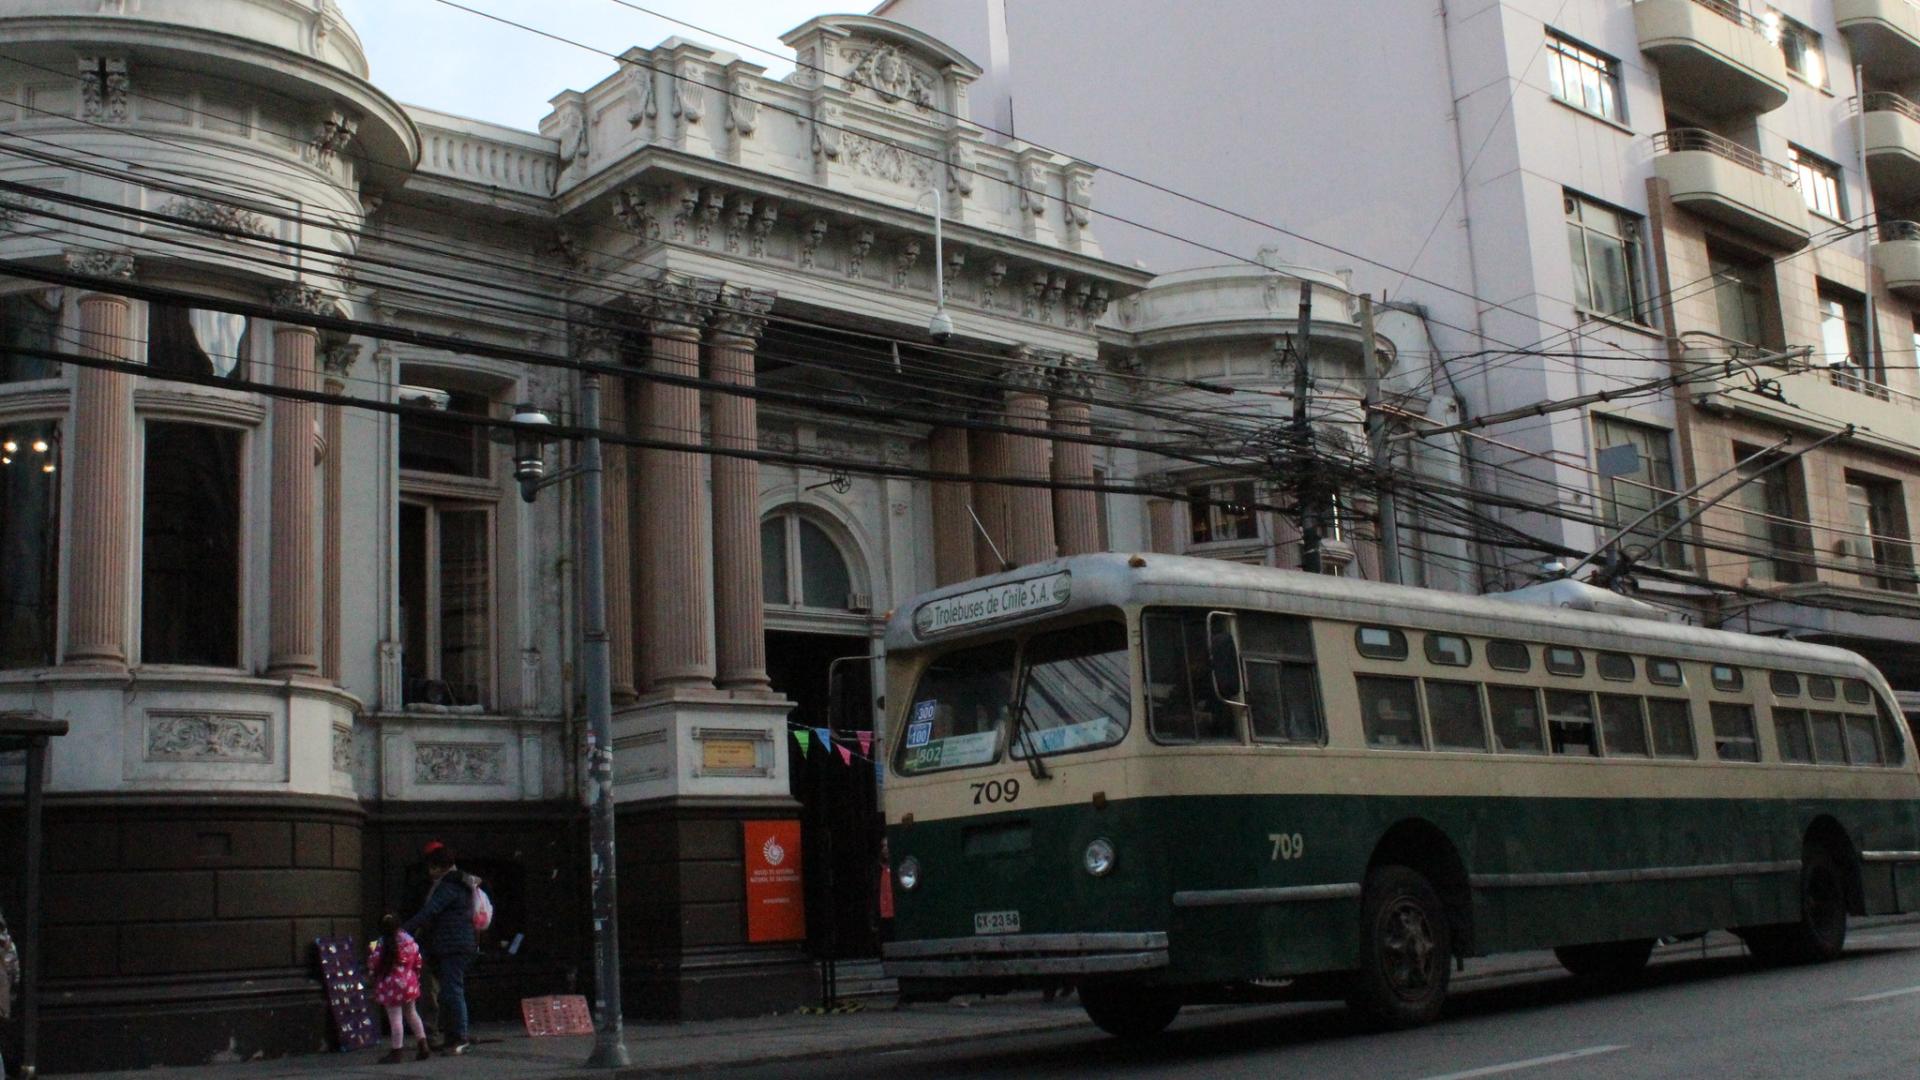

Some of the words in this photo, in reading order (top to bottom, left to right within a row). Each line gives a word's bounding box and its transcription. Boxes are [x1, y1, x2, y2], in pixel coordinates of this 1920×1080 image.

[934, 599, 984, 625] Trolebuses
[987, 596, 998, 613] de
[1002, 585, 1027, 609] Chile
[1031, 583, 1050, 604] S.A.
[970, 778, 1020, 805] 709
[1268, 832, 1304, 861] 709
